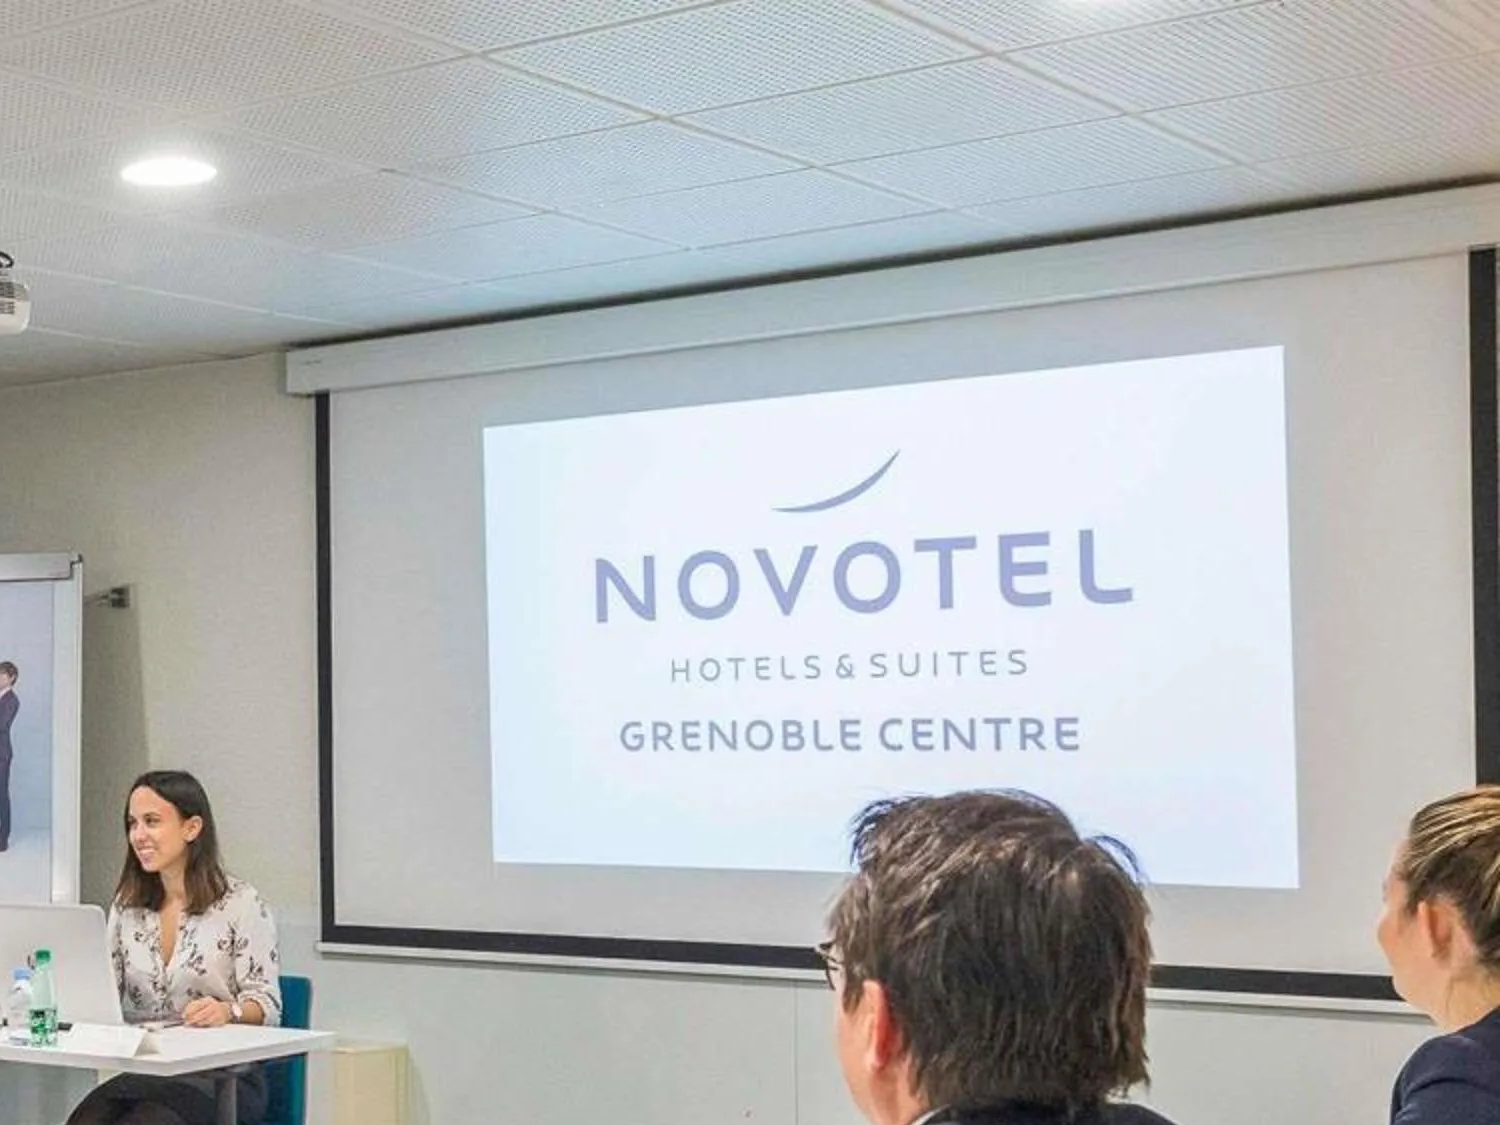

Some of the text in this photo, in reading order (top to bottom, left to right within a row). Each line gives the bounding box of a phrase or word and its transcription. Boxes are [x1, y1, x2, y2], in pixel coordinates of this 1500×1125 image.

[595, 528, 1134, 625] NOVOTEL
[670, 655, 822, 684] HOTELS
[869, 649, 1028, 679] SUITES
[619, 716, 1081, 753] GRENOBLE CENTRE
